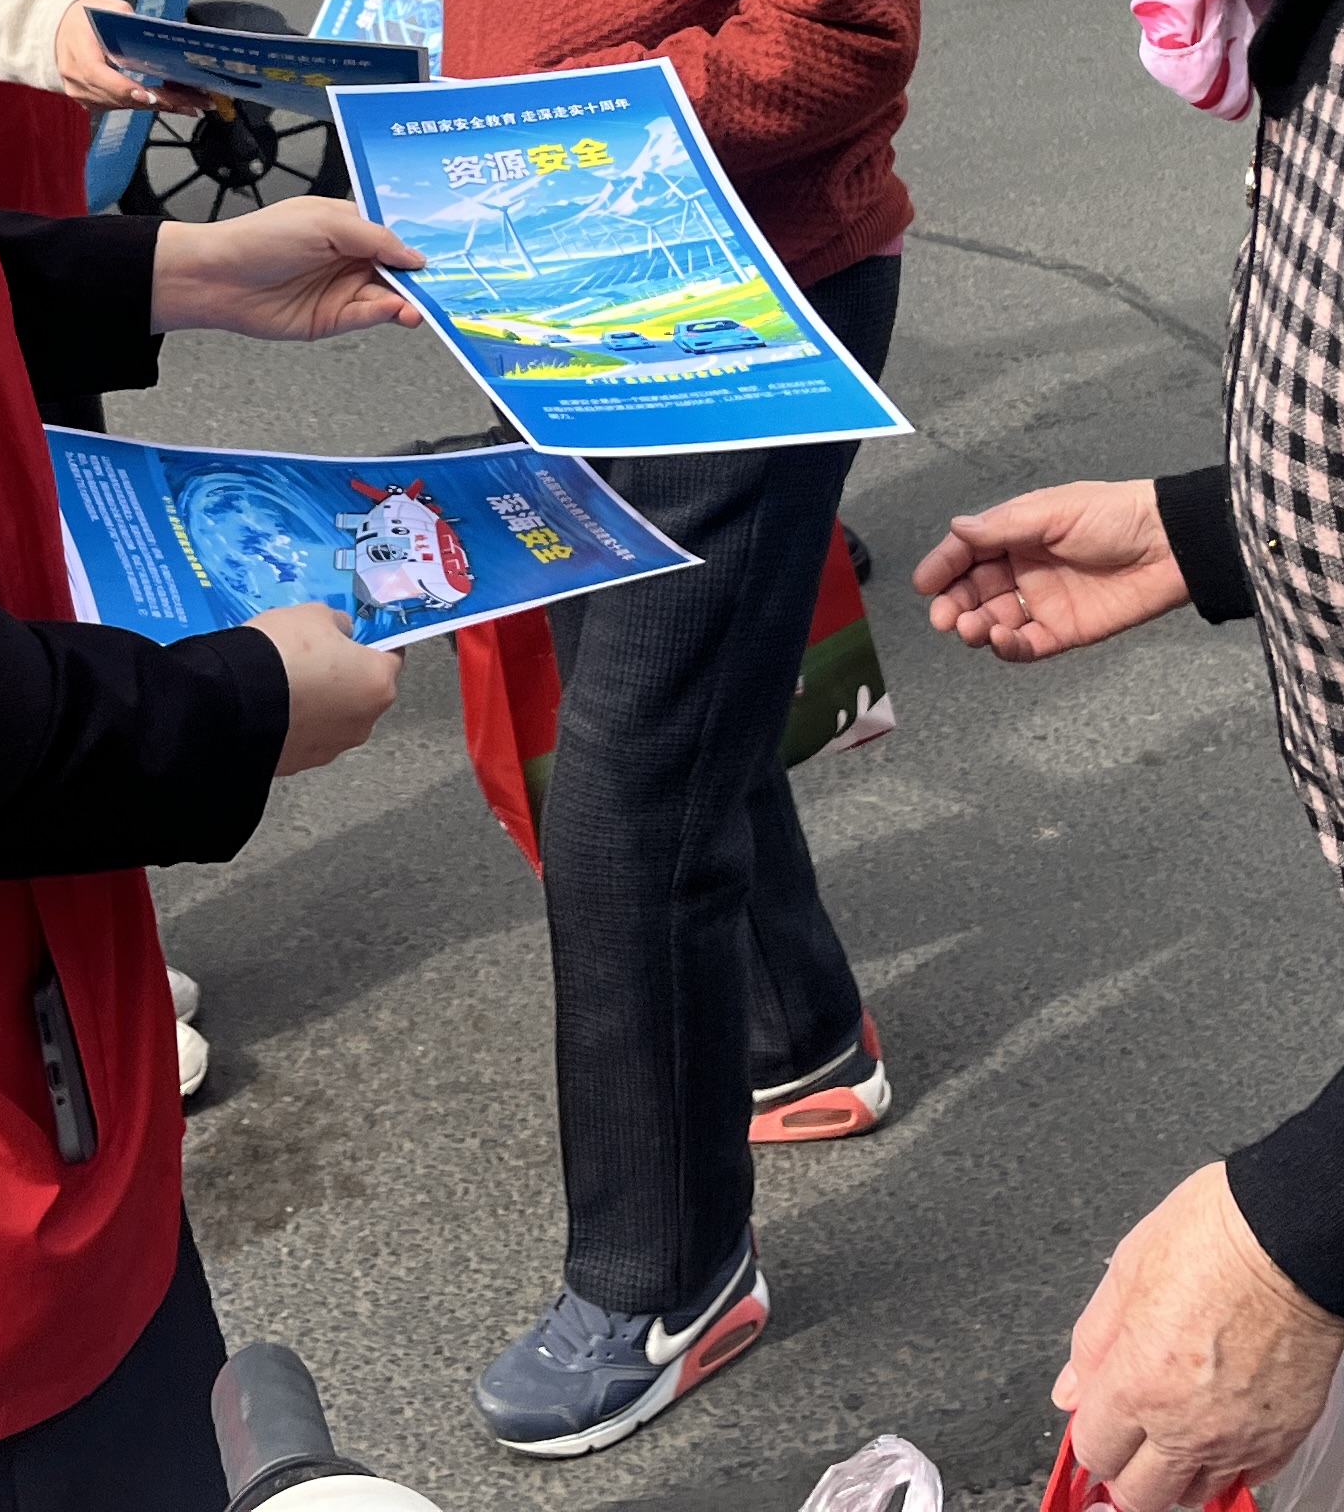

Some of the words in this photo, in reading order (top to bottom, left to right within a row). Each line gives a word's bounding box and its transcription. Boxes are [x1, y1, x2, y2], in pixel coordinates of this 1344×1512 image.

[390, 112, 517, 137] 全民国家安全教育
[521, 98, 631, 123] 走深走实十周年
[442, 138, 614, 188] 资源安全
[486, 492, 574, 566] 深海安全
